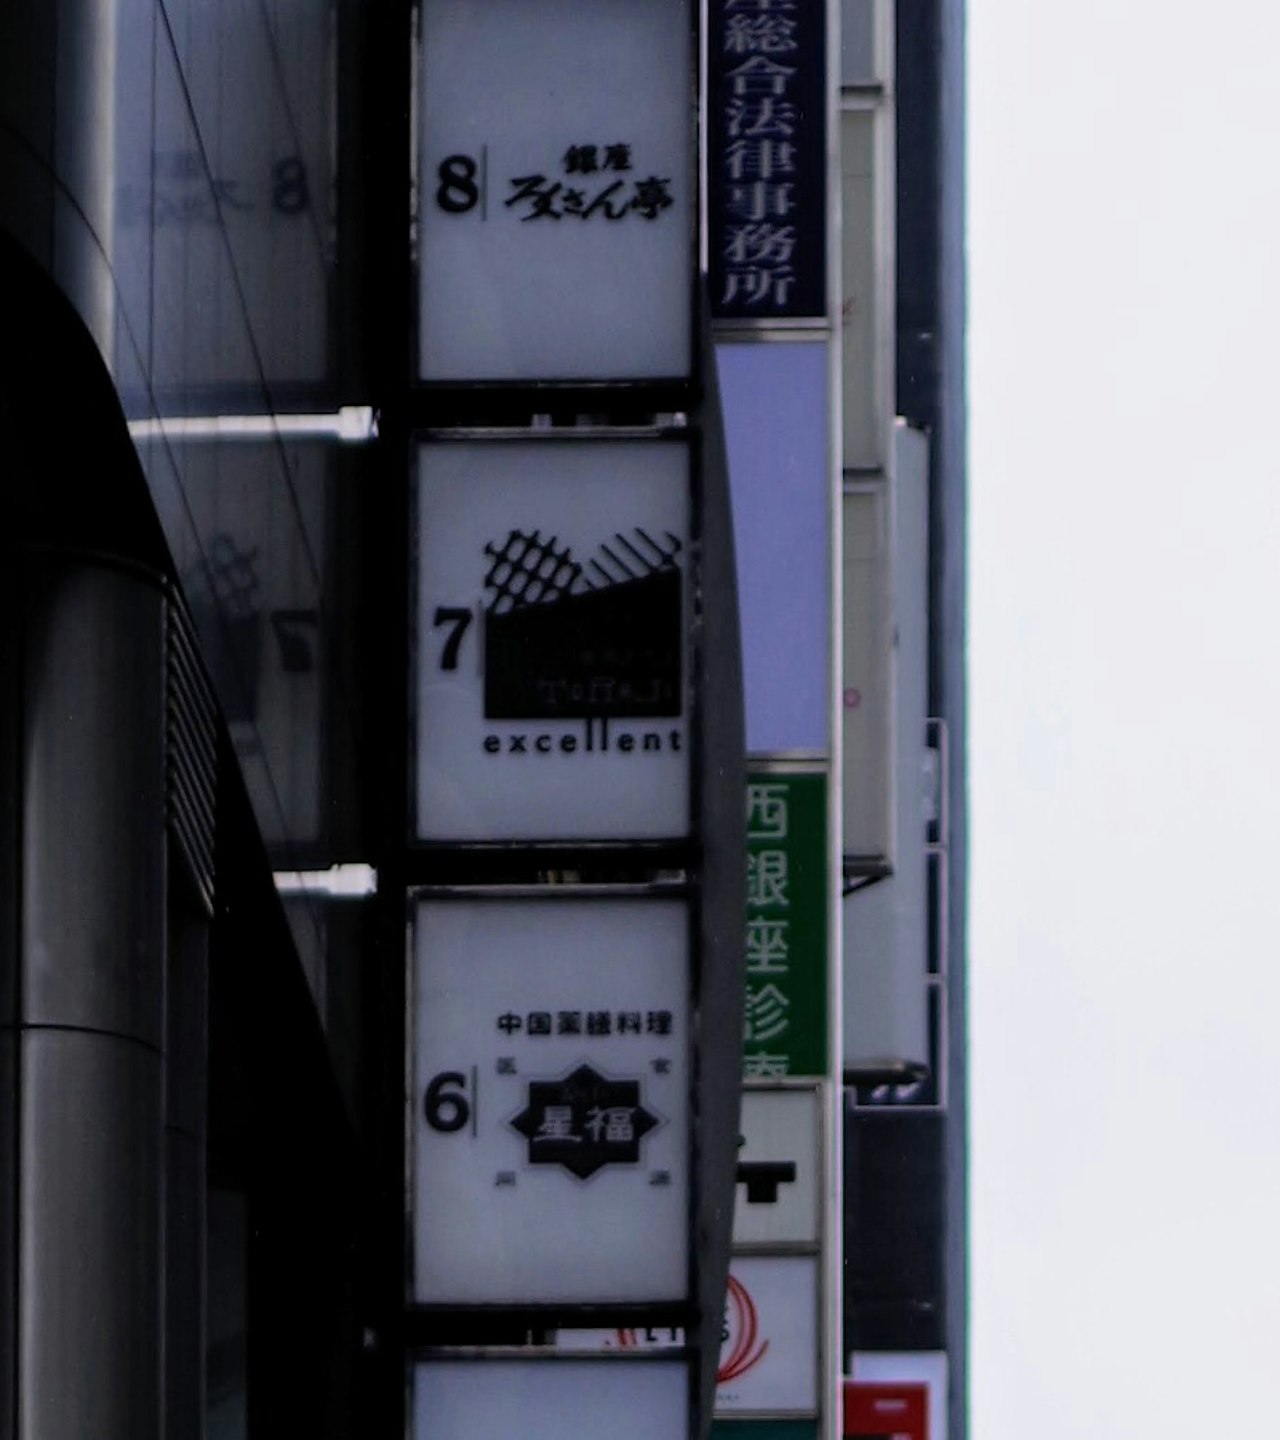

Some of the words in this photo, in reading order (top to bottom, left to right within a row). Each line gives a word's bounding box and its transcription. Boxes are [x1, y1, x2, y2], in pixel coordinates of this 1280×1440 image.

[564, 144, 632, 173] 銀座
[722, 0, 798, 305] 総合法律事務所
[437, 155, 478, 213] 8
[434, 607, 472, 670] 7
[484, 713, 681, 751] excellent
[425, 1071, 469, 1133] 6
[533, 1104, 638, 1143] 星福
